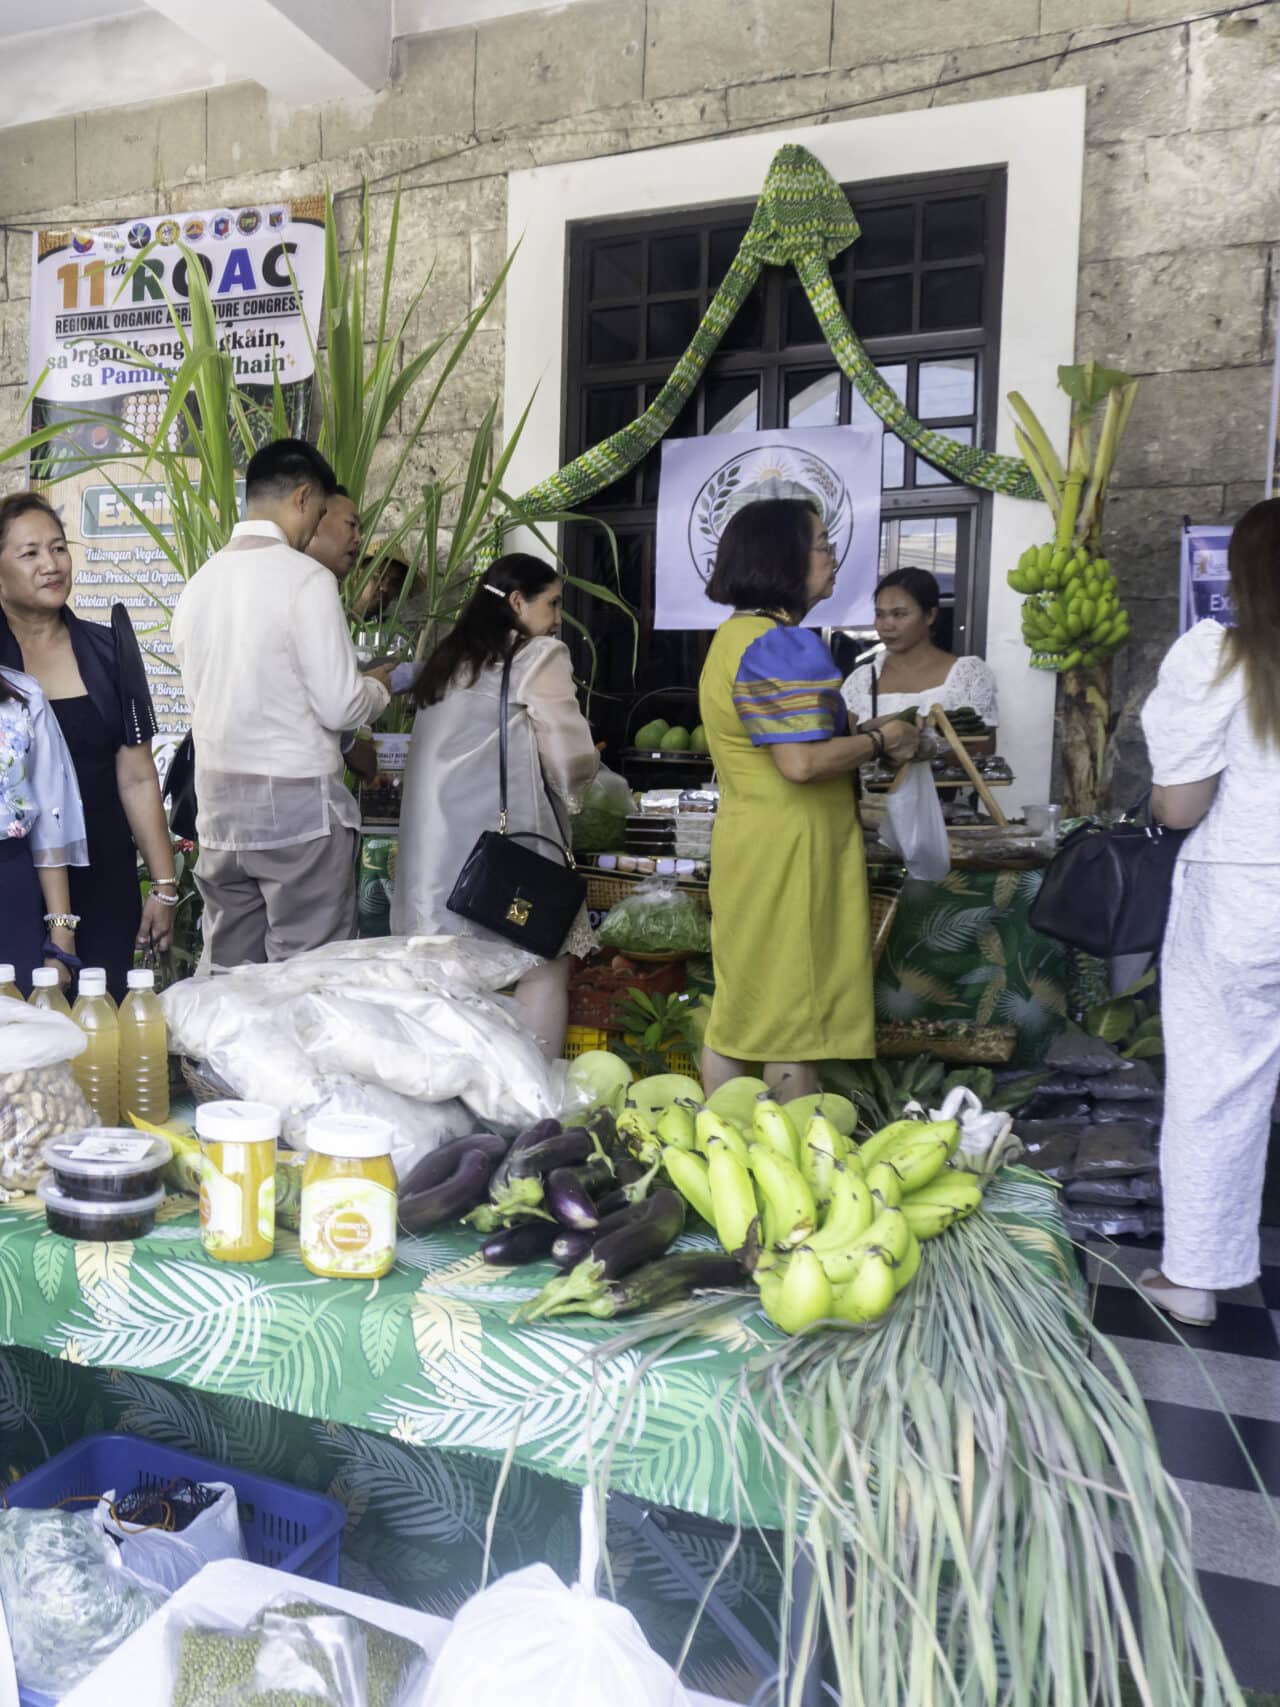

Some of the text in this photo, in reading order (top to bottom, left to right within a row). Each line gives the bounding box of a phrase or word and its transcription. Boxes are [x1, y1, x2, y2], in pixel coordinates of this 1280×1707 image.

[131, 242, 298, 302] ROAC
[55, 314, 110, 334] REGIONAL
[113, 309, 163, 329] ORGANIC
[166, 301, 240, 324] AGRIURE
[47, 355, 68, 370] sa
[70, 373, 93, 388] sa
